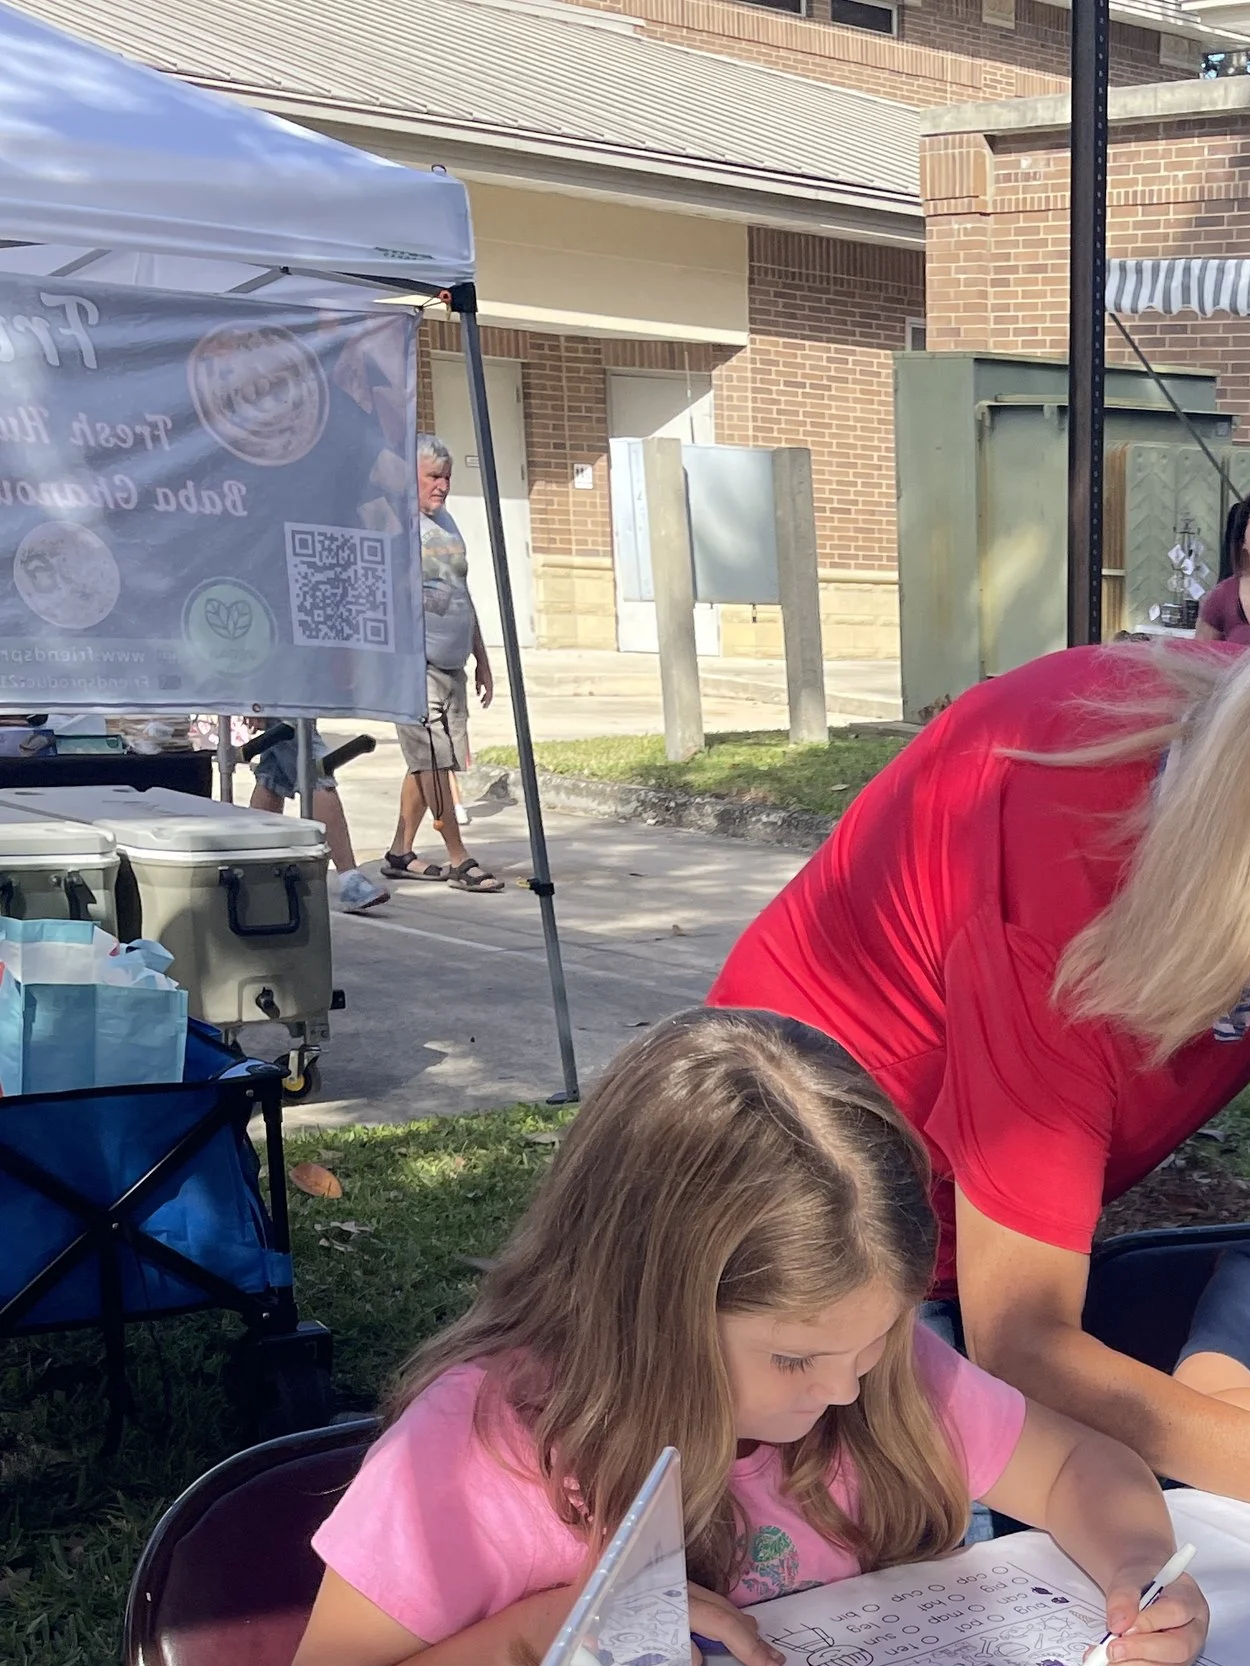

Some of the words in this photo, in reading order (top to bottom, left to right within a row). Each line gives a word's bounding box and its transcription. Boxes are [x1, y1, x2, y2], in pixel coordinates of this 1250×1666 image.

[983, 1581, 1008, 1594] pig
[1012, 1601, 1050, 1616] bug
[829, 1610, 861, 1623] bin
[846, 1621, 881, 1635] leg
[954, 1618, 984, 1634] pot
[862, 1632, 898, 1647] sun
[882, 1643, 920, 1656] ten
